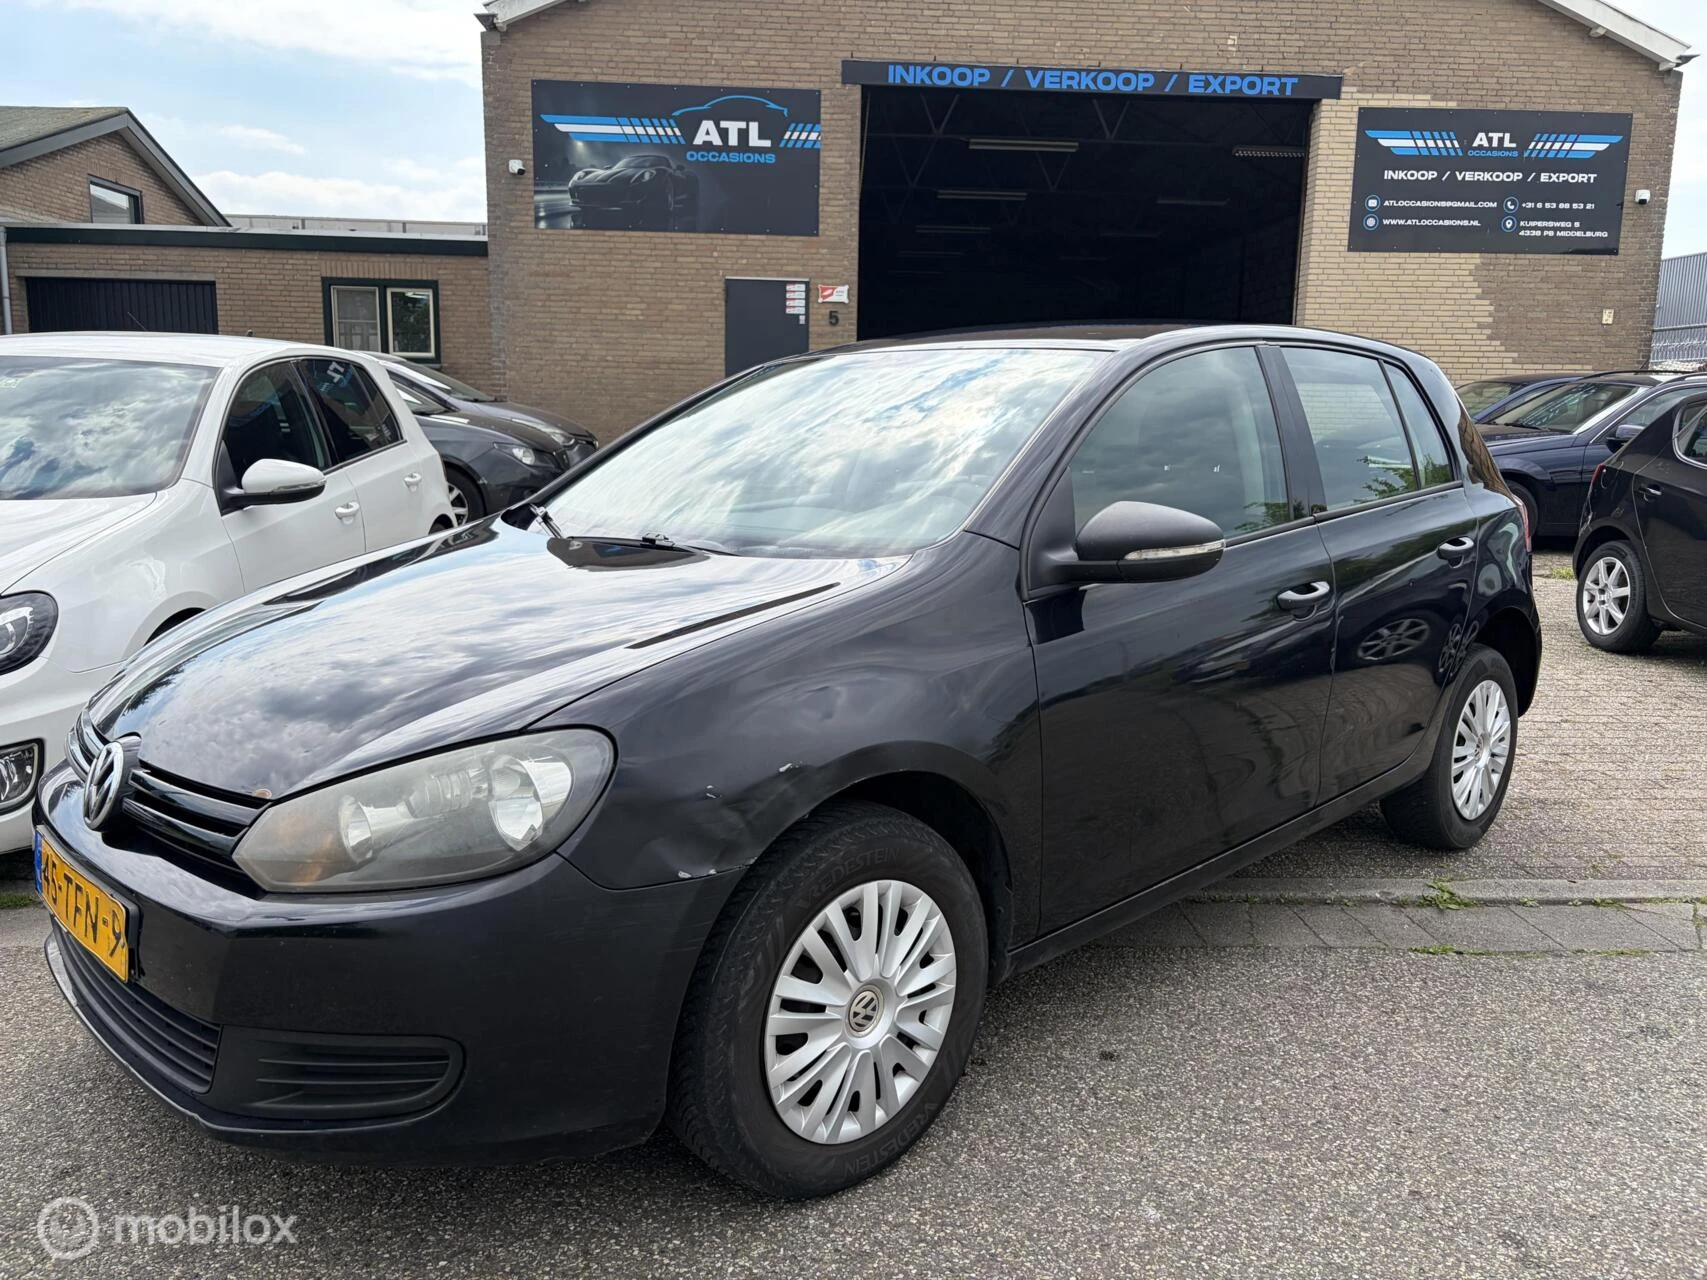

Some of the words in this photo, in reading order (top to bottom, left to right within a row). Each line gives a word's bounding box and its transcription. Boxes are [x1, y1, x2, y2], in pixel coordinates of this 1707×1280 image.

[887, 64, 990, 86] INKOOP
[1001, 69, 1014, 88] /
[1025, 69, 1155, 92] VERKOOP
[1164, 73, 1178, 92] /
[1188, 74, 1299, 96] EXPORT
[692, 119, 772, 148] ATL
[1472, 131, 1517, 148] ATL
[686, 150, 776, 164] OCCASIONS
[1467, 149, 1519, 158] OCCASIONS
[1384, 170, 1438, 181] INKOOP
[1442, 171, 1451, 182] /
[1455, 171, 1523, 182] VERKOOP
[1527, 172, 1536, 182] /
[1540, 172, 1598, 183] EXPORT
[1382, 218, 1481, 226] WWW.ATLOCCASIONS.NL
[828, 310, 839, 326] 5
[42, 852, 122, 958] 45-TFN-9
